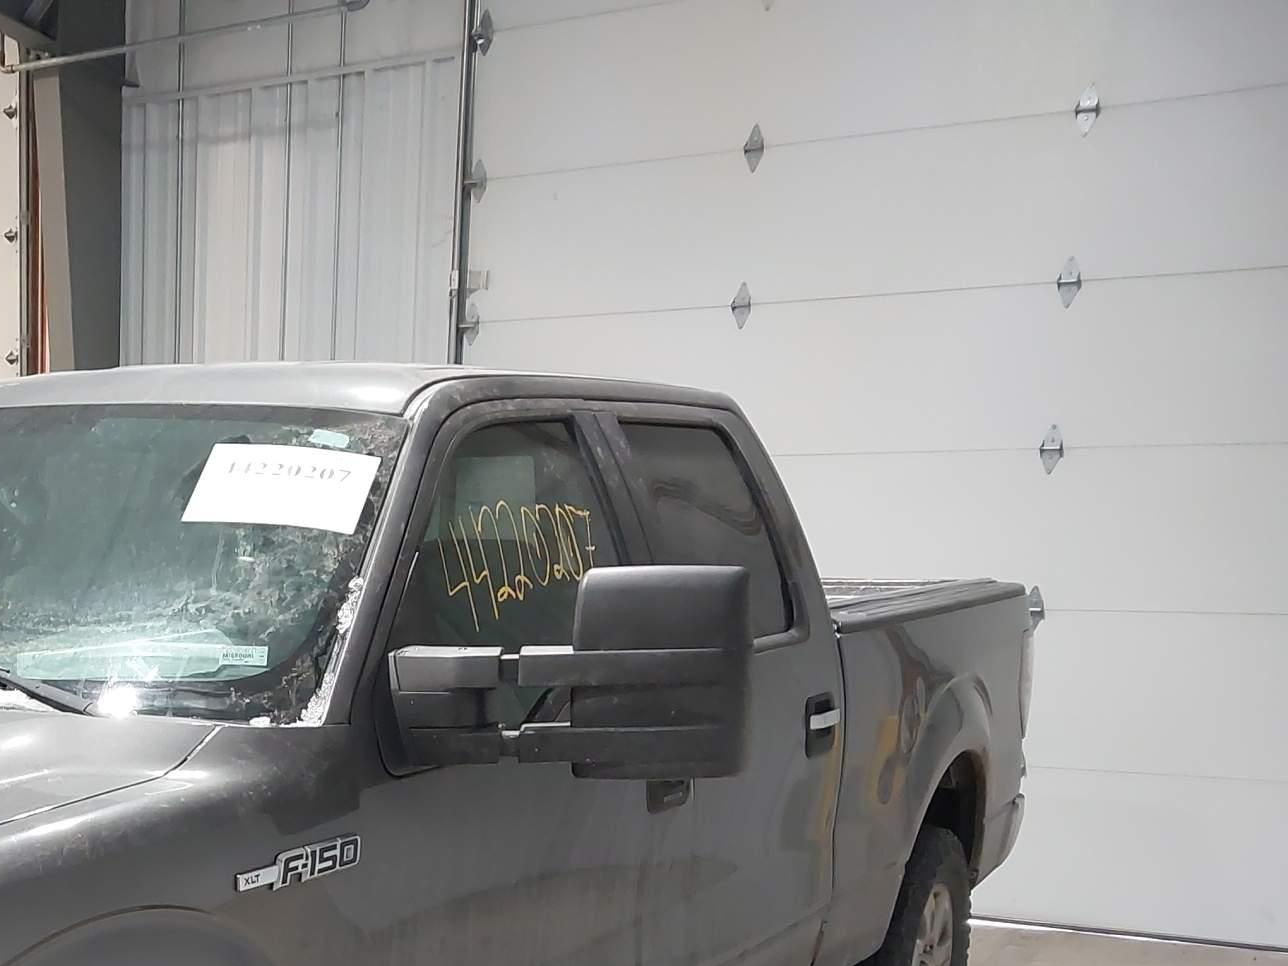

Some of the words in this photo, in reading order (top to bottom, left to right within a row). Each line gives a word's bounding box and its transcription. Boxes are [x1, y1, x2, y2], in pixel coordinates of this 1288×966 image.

[437, 499, 596, 633] 44220207
[243, 873, 261, 887] XLT
[275, 836, 361, 889] F-150
